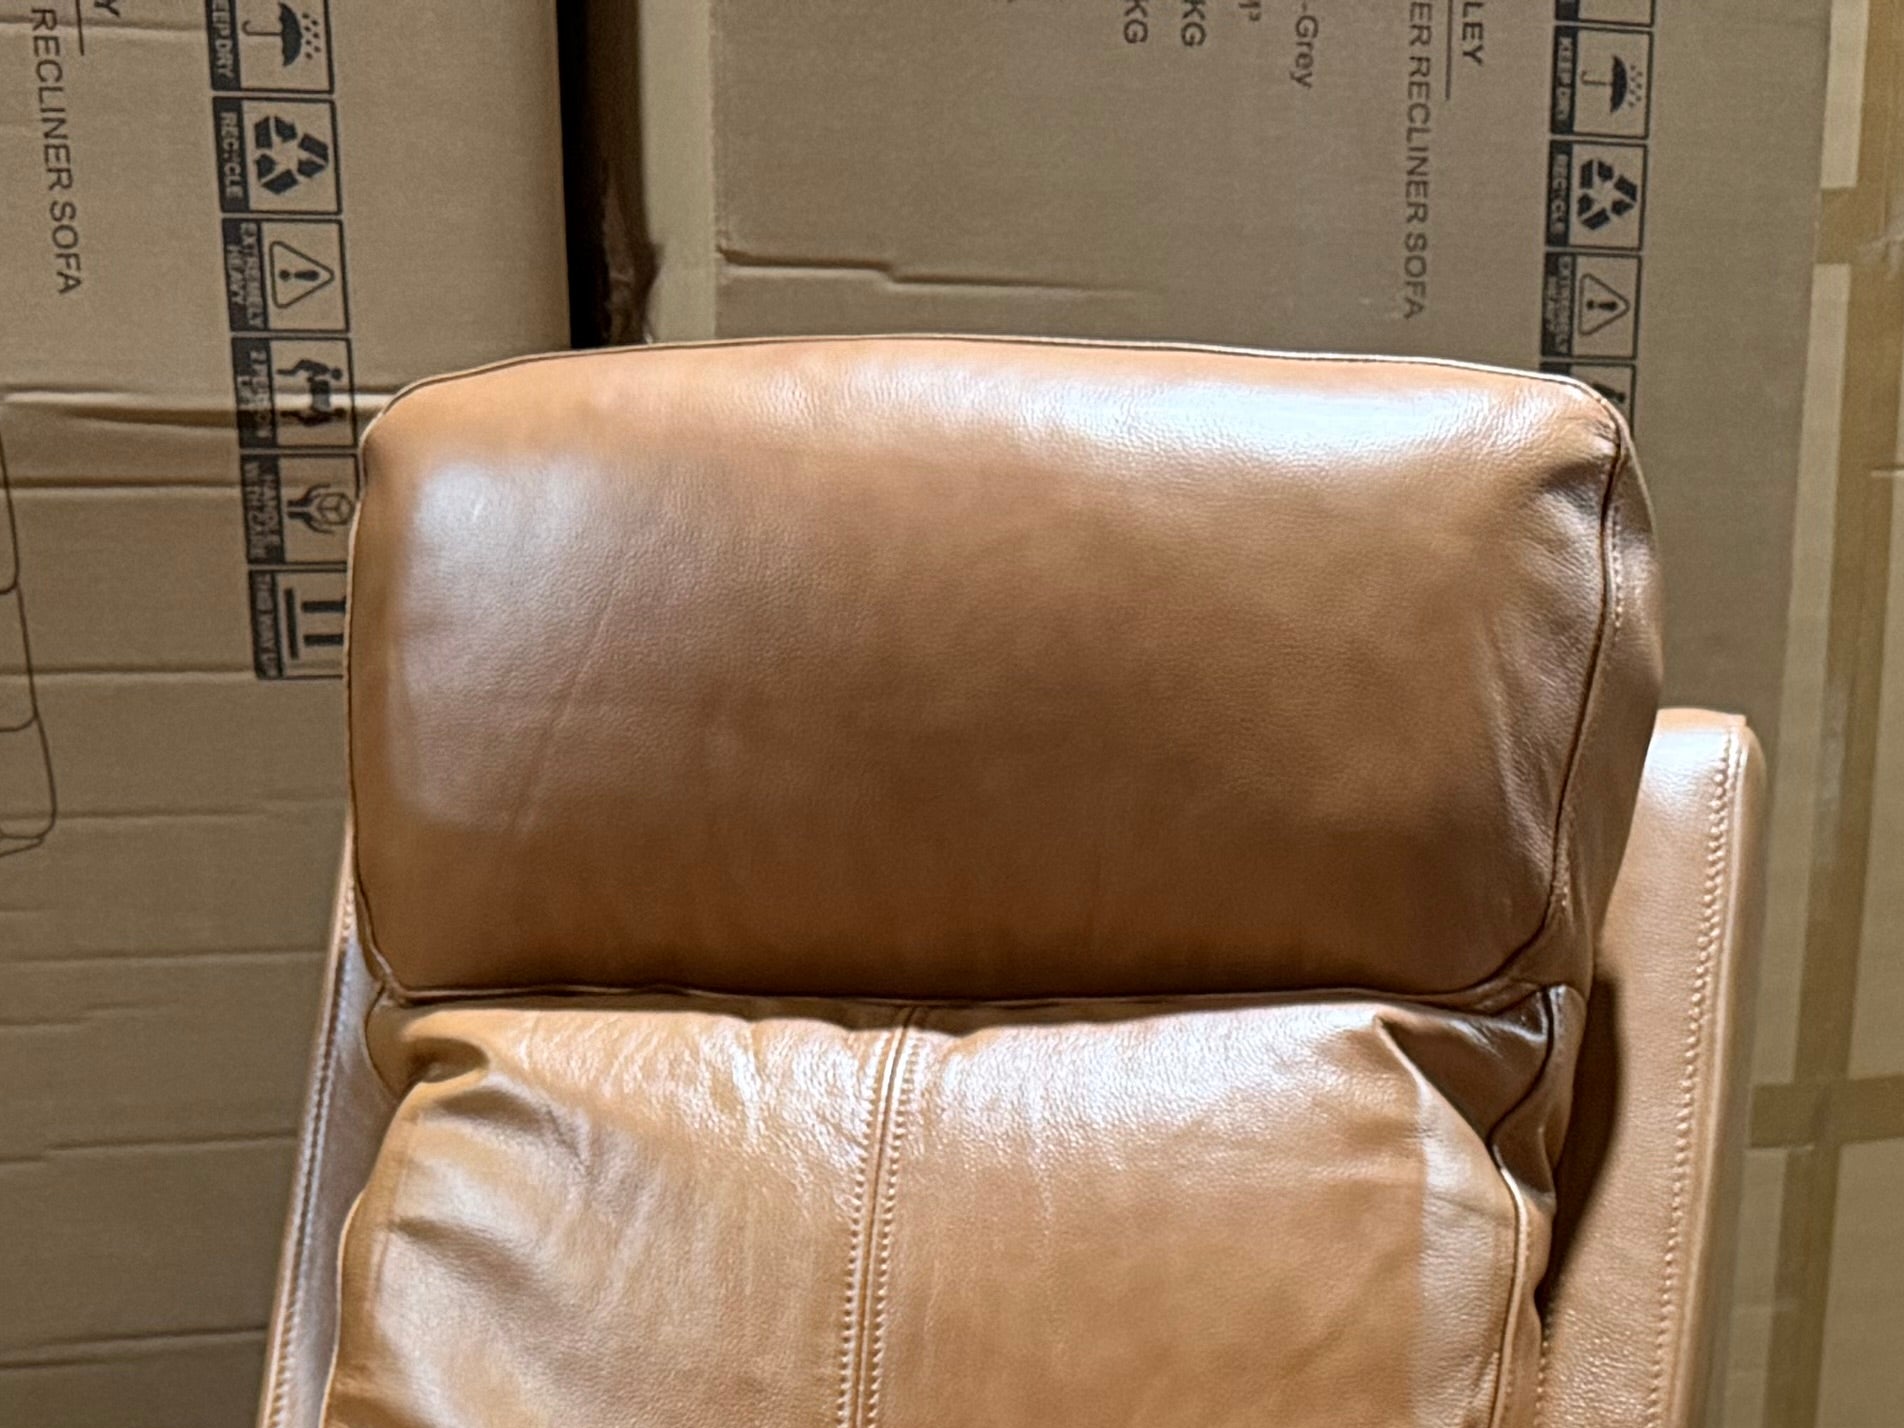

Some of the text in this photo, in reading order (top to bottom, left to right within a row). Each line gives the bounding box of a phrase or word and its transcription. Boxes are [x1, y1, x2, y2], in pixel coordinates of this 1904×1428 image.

[31, 8, 82, 294] RECLINER SOFA
[219, 111, 243, 200] RECYCLE
[1405, 56, 1432, 224] RECLINER
[1404, 232, 1428, 320] SOFA
